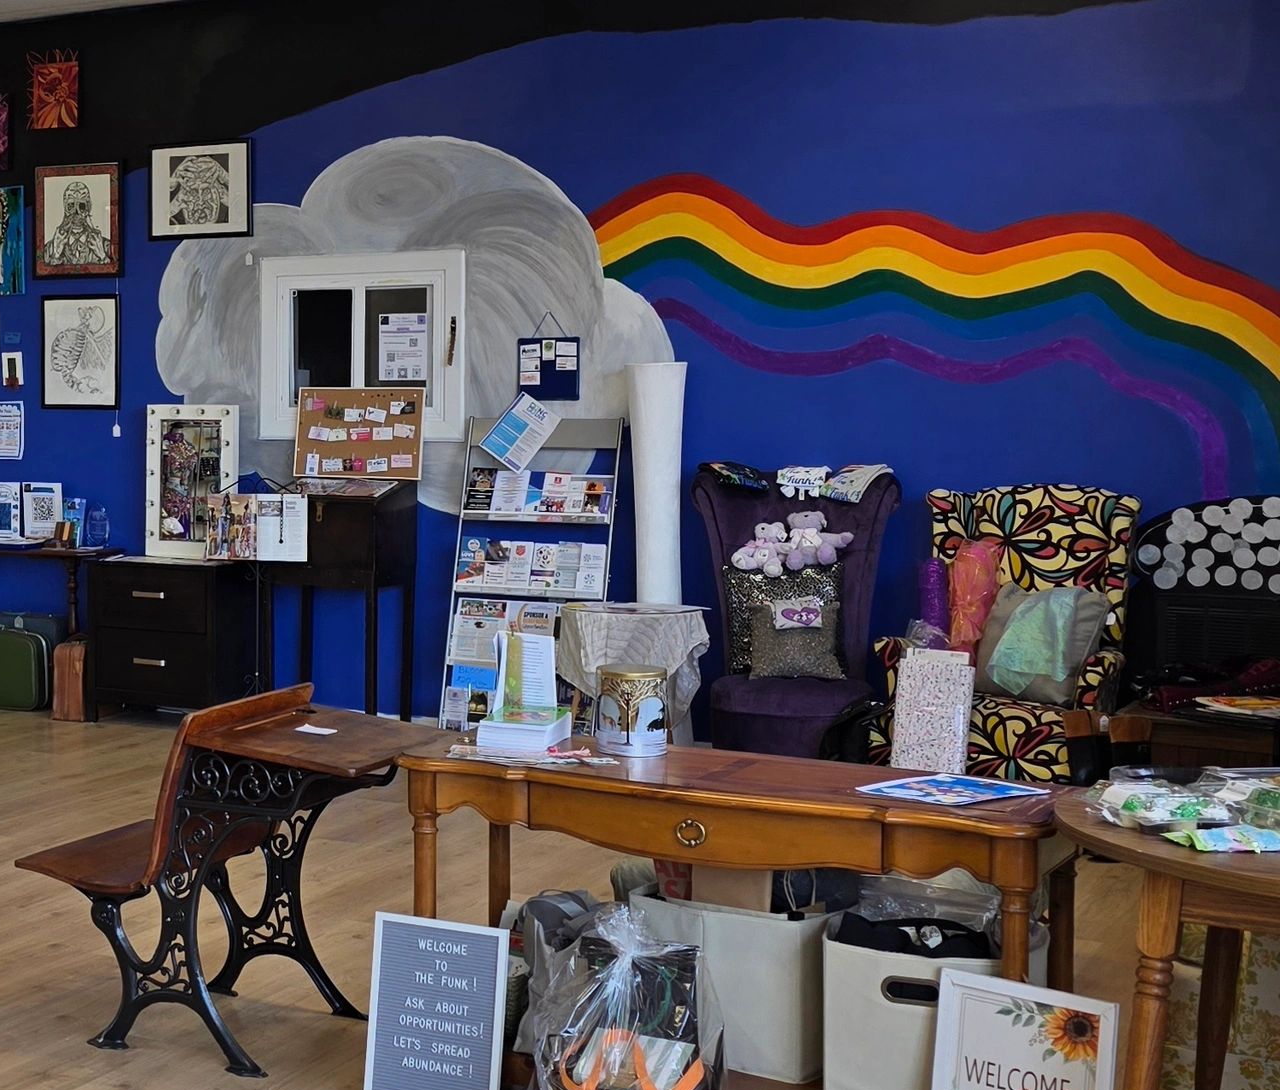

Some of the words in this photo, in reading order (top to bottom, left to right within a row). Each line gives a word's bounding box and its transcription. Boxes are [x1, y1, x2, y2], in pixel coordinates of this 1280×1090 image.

[418, 938, 468, 956] WELCOME
[434, 959, 448, 972] TO
[414, 971, 435, 985] THE
[404, 996, 425, 1010] ASK
[435, 1002, 469, 1017] ABOUT
[399, 1013, 484, 1039] OPPORTUNITIES!
[393, 1035, 421, 1051] LET'S
[431, 1042, 471, 1059] SPREAD
